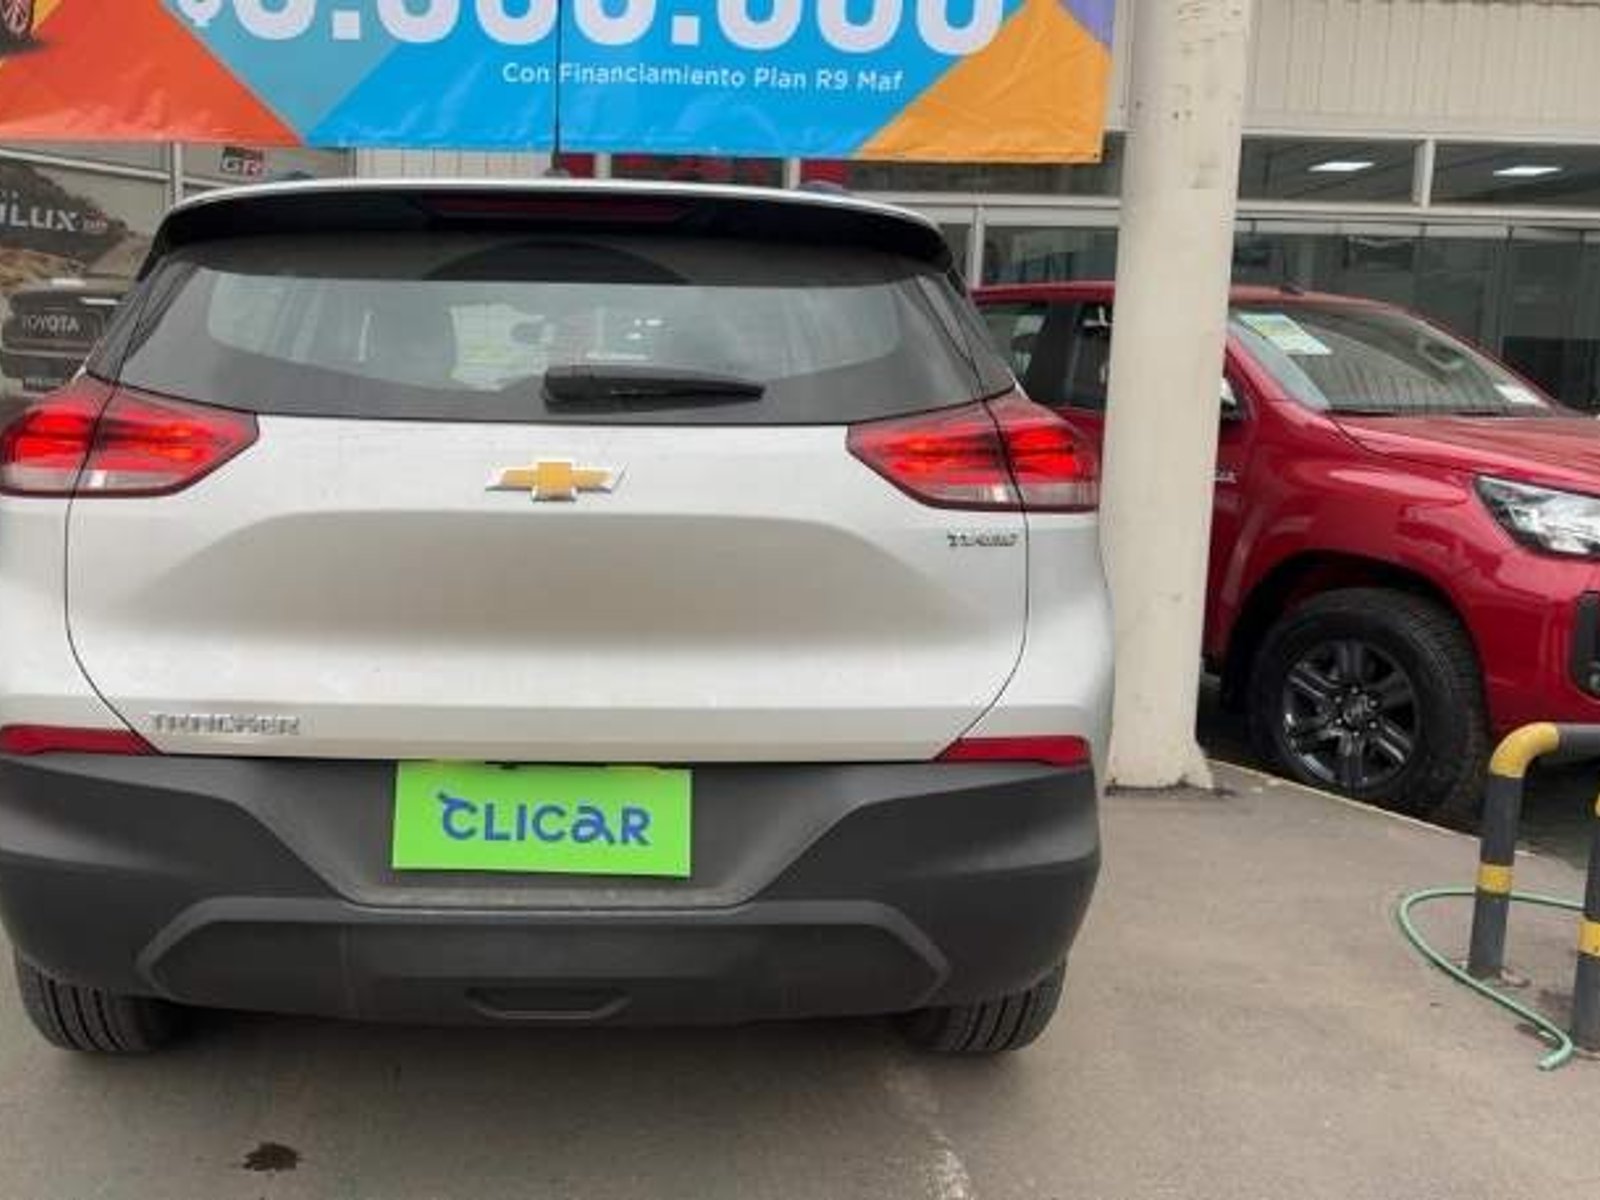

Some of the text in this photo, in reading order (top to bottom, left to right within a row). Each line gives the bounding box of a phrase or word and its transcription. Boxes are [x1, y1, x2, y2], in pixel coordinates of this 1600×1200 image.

[502, 61, 904, 93] Con Financiamiento Plan R9 Maf
[22, 313, 80, 333] TOYOTA
